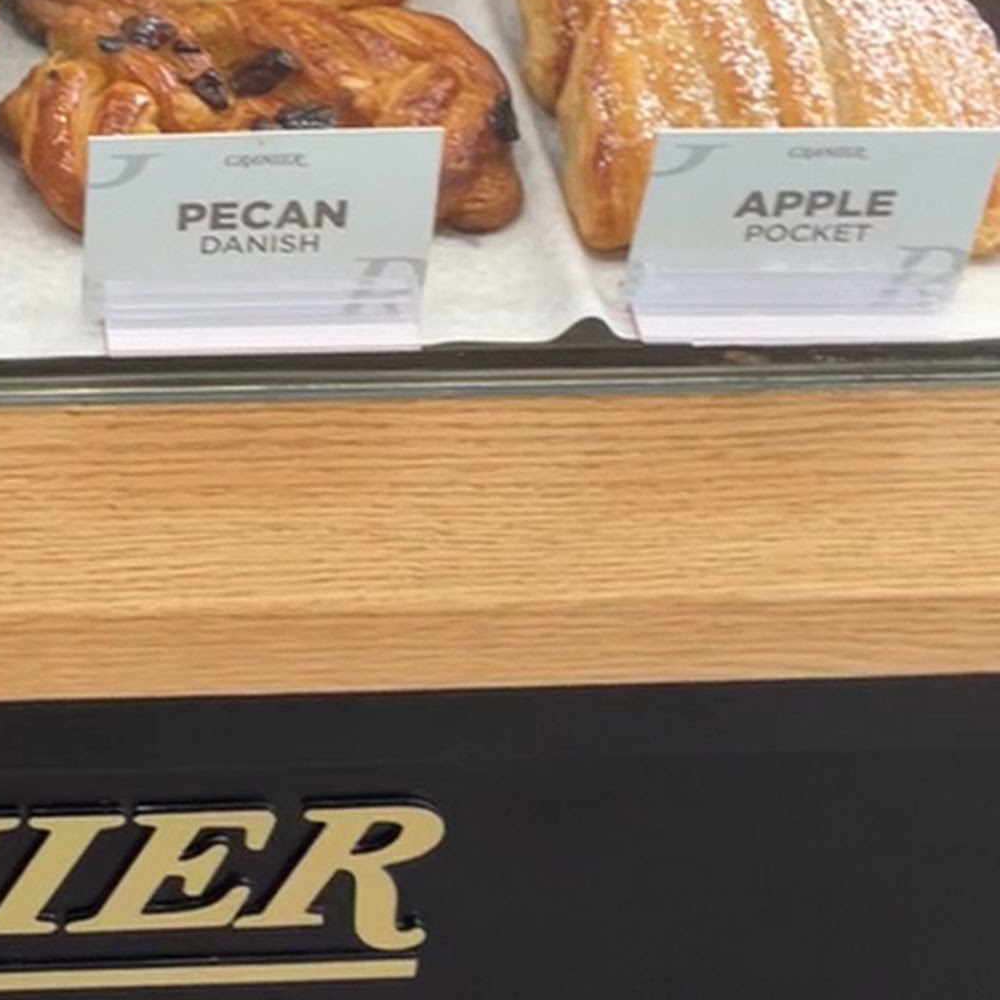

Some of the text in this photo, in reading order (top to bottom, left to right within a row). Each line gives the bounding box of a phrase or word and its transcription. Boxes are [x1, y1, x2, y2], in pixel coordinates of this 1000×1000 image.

[176, 200, 348, 232] PECAN
[733, 190, 898, 218] APPLE
[200, 234, 320, 255] DANISH
[744, 224, 872, 243] POCKET
